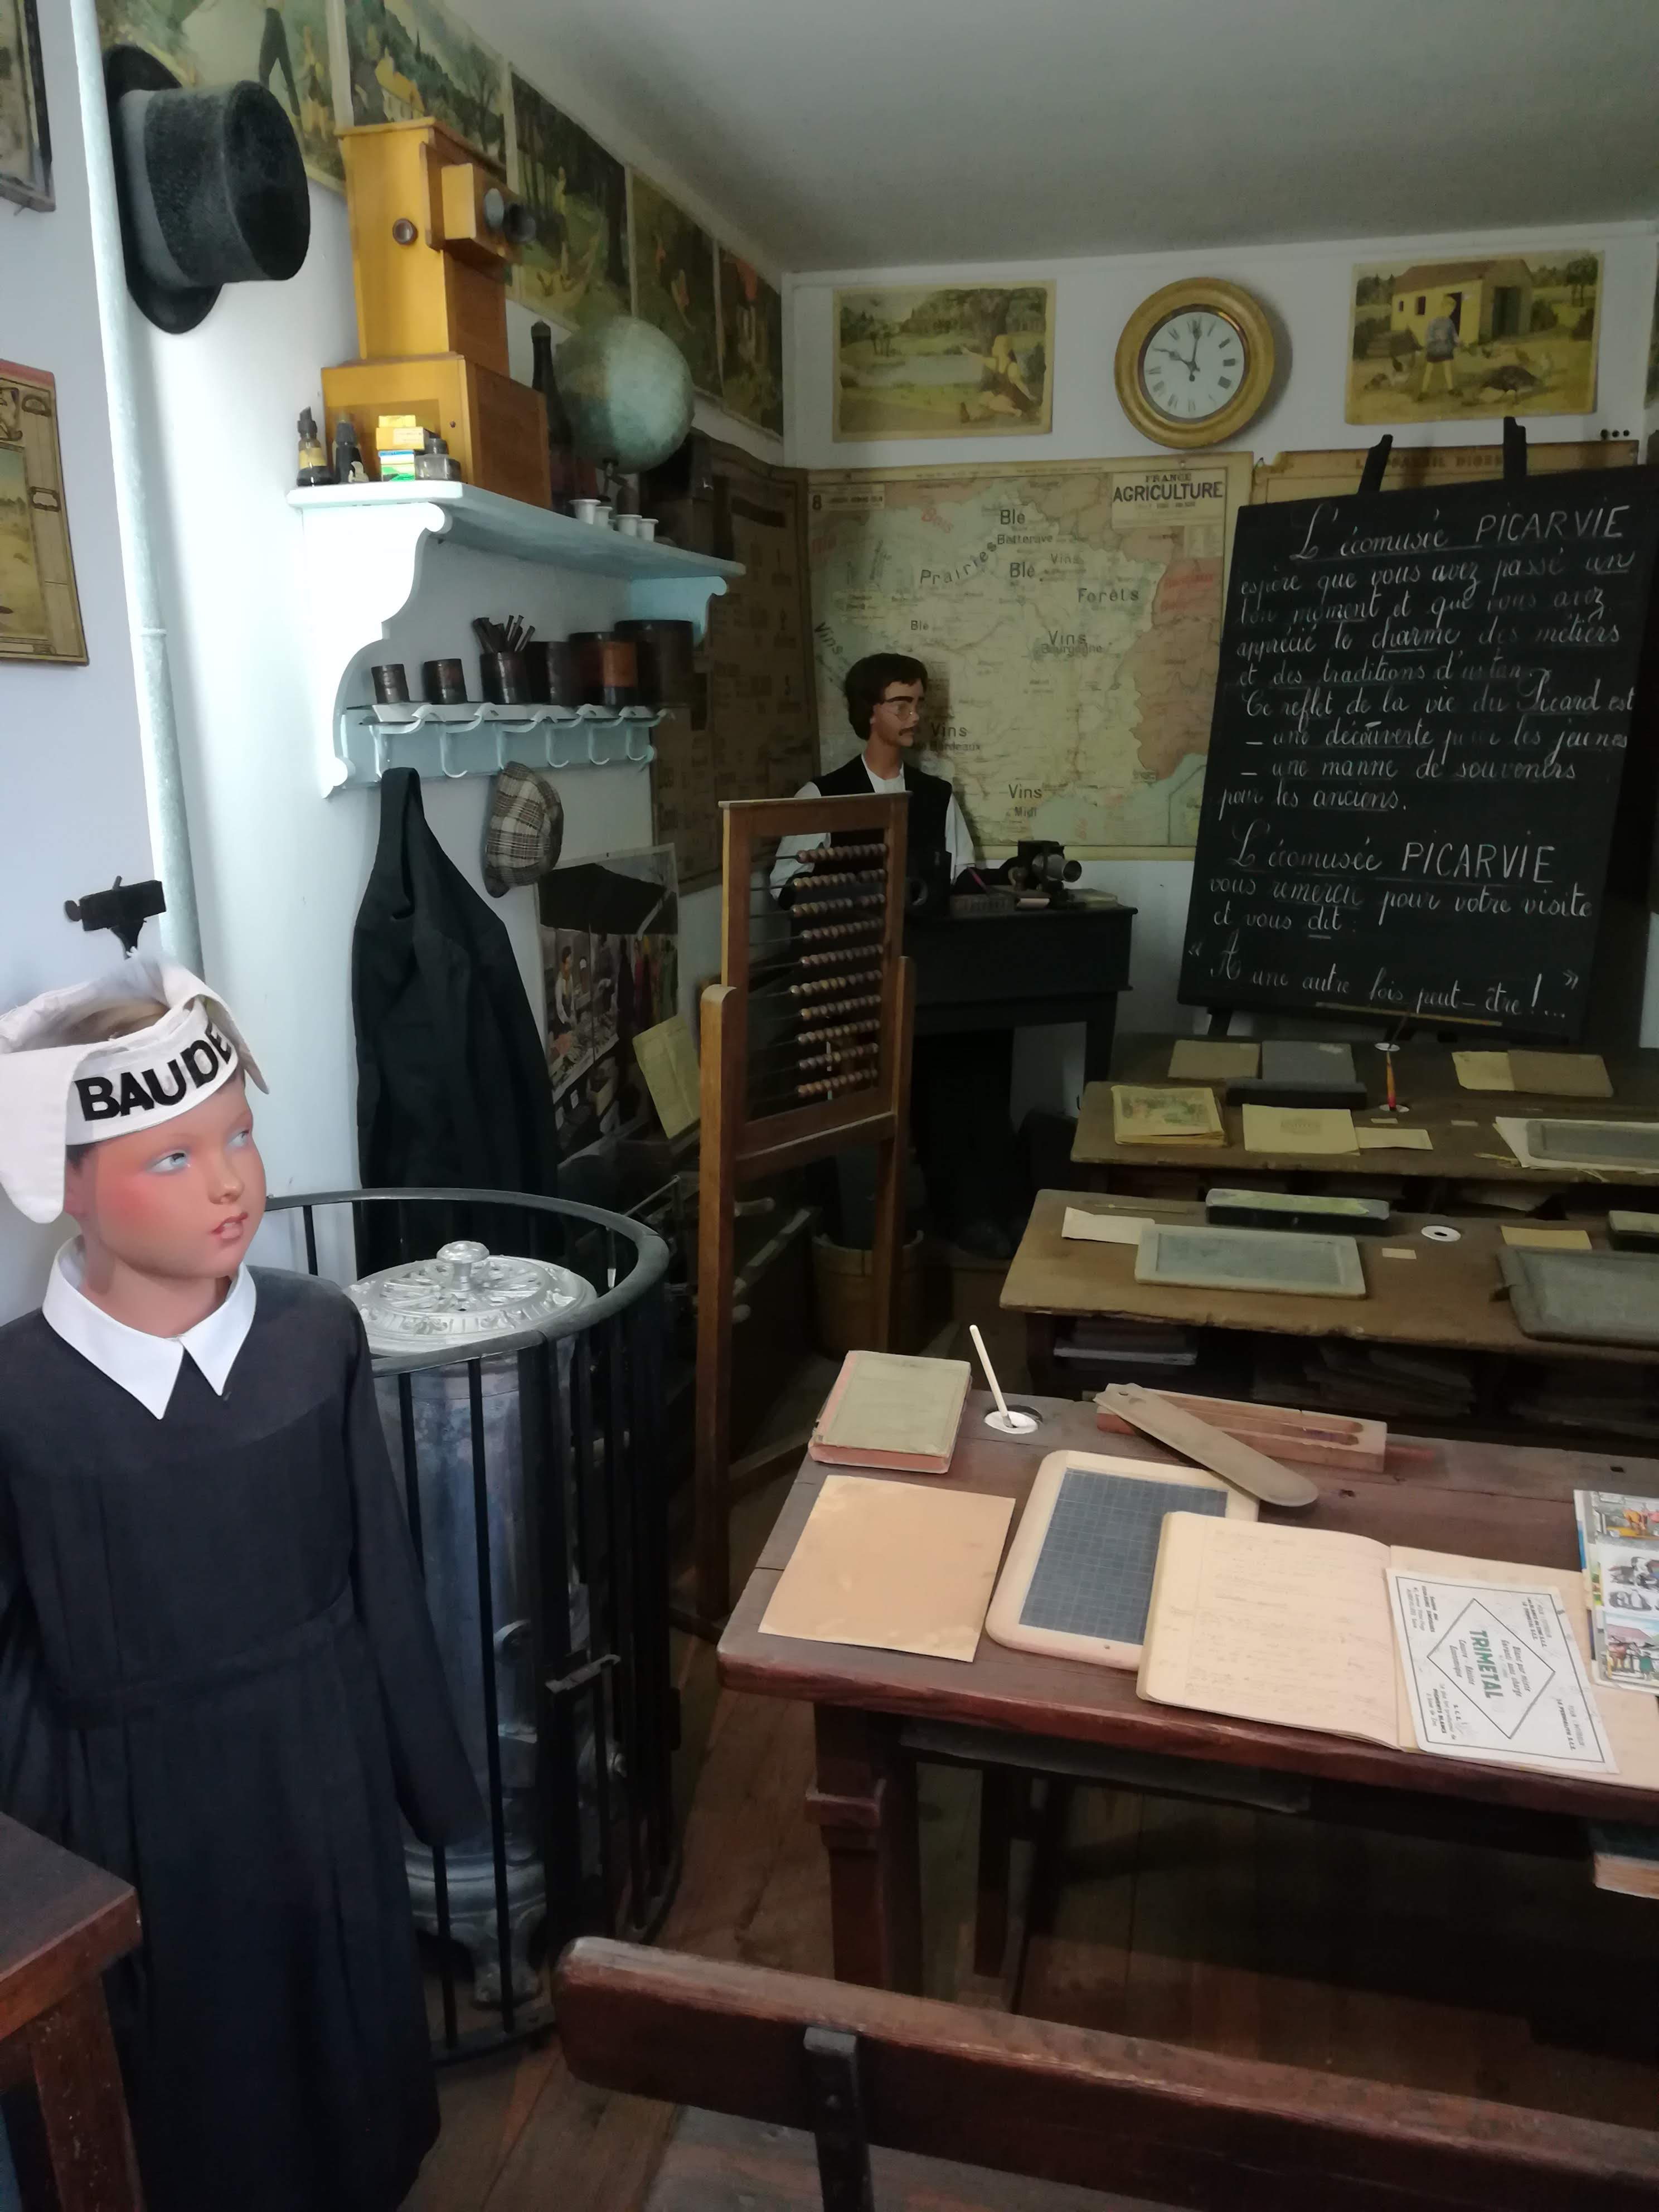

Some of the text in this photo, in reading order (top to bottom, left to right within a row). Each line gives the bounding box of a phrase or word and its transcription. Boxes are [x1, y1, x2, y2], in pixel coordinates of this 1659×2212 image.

[1114, 481, 1223, 502] AGRICULTURE
[1146, 473, 1191, 483] FRANCE
[812, 495, 822, 510] 8
[1476, 502, 1630, 543] PICARVIE
[1317, 572, 1357, 605] que
[1371, 564, 1421, 586] vous
[1432, 561, 1480, 601] avez
[1293, 588, 1382, 624] moment
[1393, 589, 1412, 617] et
[1431, 596, 1474, 629] que
[1048, 630, 1086, 645] Vins
[1334, 622, 1353, 650] le
[1372, 616, 1462, 649] charme
[1479, 615, 1517, 644] des
[1240, 662, 1258, 686] et
[1274, 659, 1303, 684] des
[1322, 655, 1425, 683] traditions
[1346, 686, 1372, 714] de
[1382, 686, 1409, 714] la
[1425, 685, 1456, 714] vie
[1473, 682, 1507, 713] du
[1608, 686, 1637, 711] est
[931, 722, 968, 737] Vins
[1273, 729, 1311, 746] une
[1326, 717, 1434, 746] découverte
[1514, 714, 1541, 745] les
[1544, 717, 1628, 767] jeunes
[1273, 760, 1309, 777] une
[1322, 759, 1399, 778] manne
[1417, 749, 1444, 779] de
[1008, 783, 1042, 798] Vins
[1219, 788, 1264, 821] pour
[1276, 780, 1299, 807] les
[1401, 830, 1555, 883] PICARVIE
[1210, 879, 1257, 895] vous
[1379, 891, 1441, 926] pour
[1454, 885, 1512, 914] votre
[1521, 882, 1593, 917] visite
[1214, 900, 1231, 925] et
[1246, 914, 1292, 930] vous
[1253, 970, 1289, 986] une
[1302, 963, 1352, 994] autre
[1369, 967, 1404, 1001] fois
[74, 1022, 233, 1122] BAUDE
[1469, 1629, 1504, 1699] TRIMETAL
